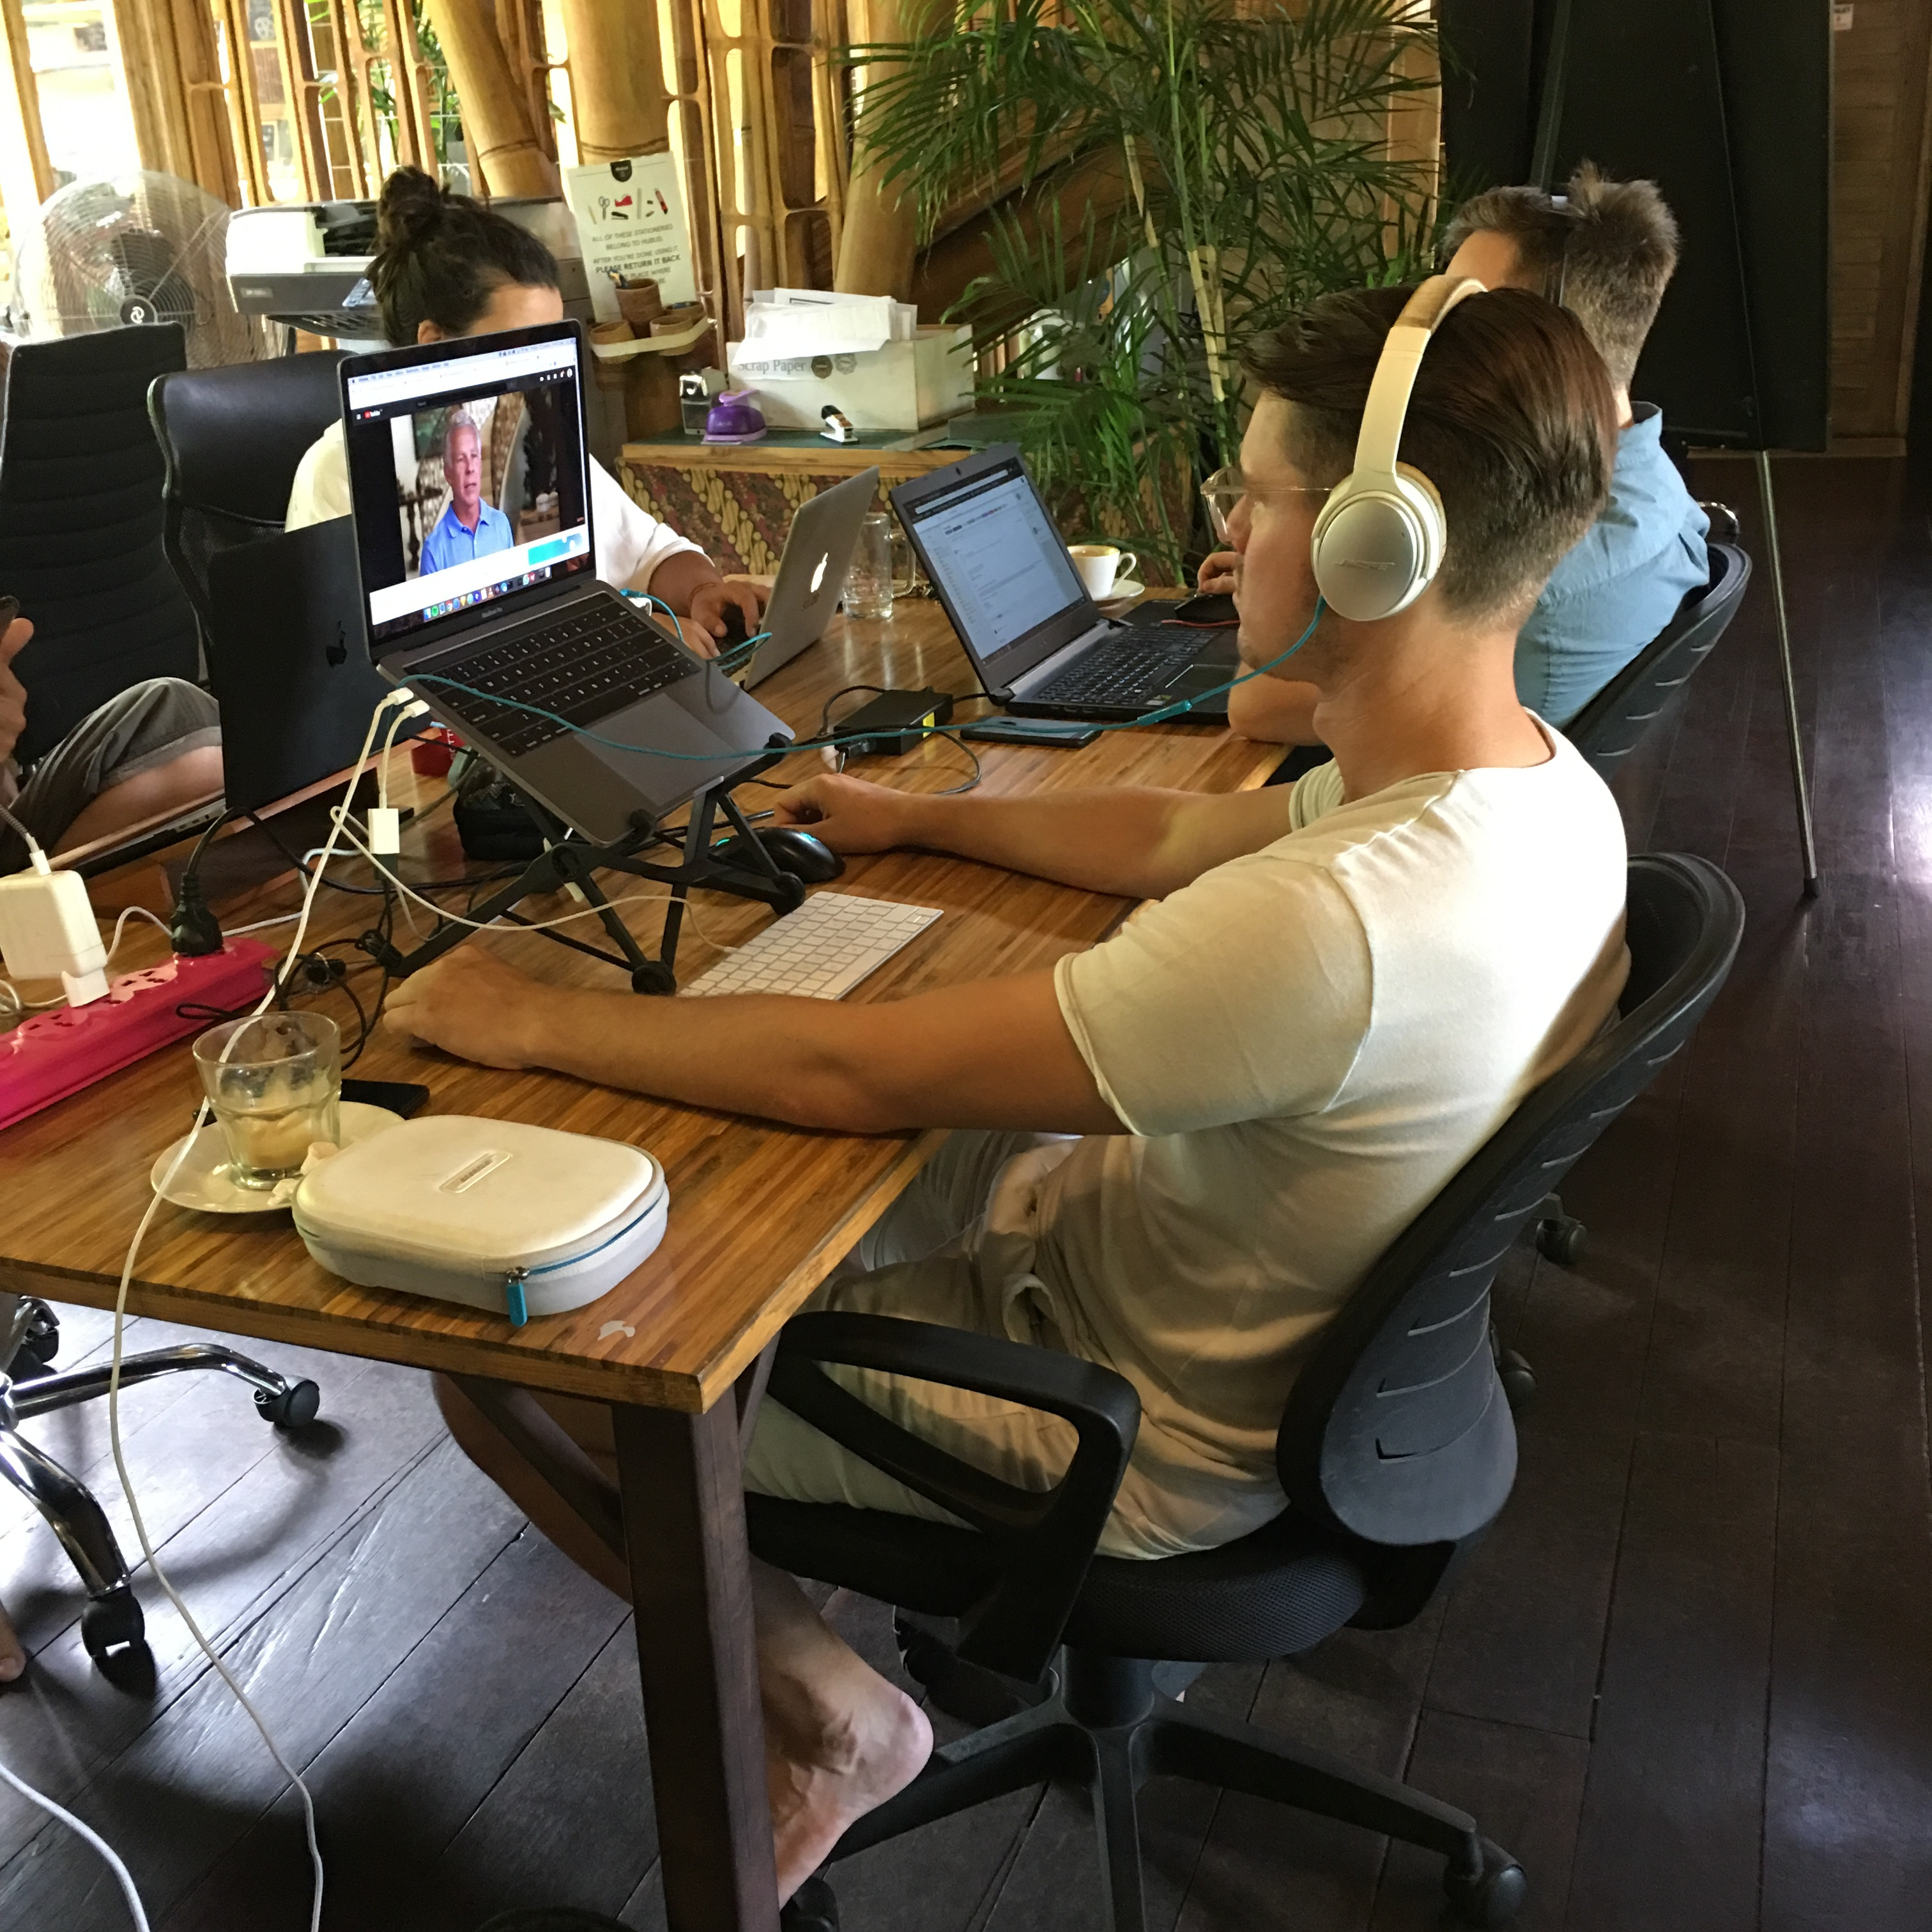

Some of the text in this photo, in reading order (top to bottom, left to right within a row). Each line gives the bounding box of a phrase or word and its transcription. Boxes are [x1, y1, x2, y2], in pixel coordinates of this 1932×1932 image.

[606, 241, 631, 250] BELONG
[636, 250, 652, 259] DONE
[624, 260, 652, 270] RETURN
[662, 254, 681, 264] BACK
[773, 360, 806, 374] Paper
